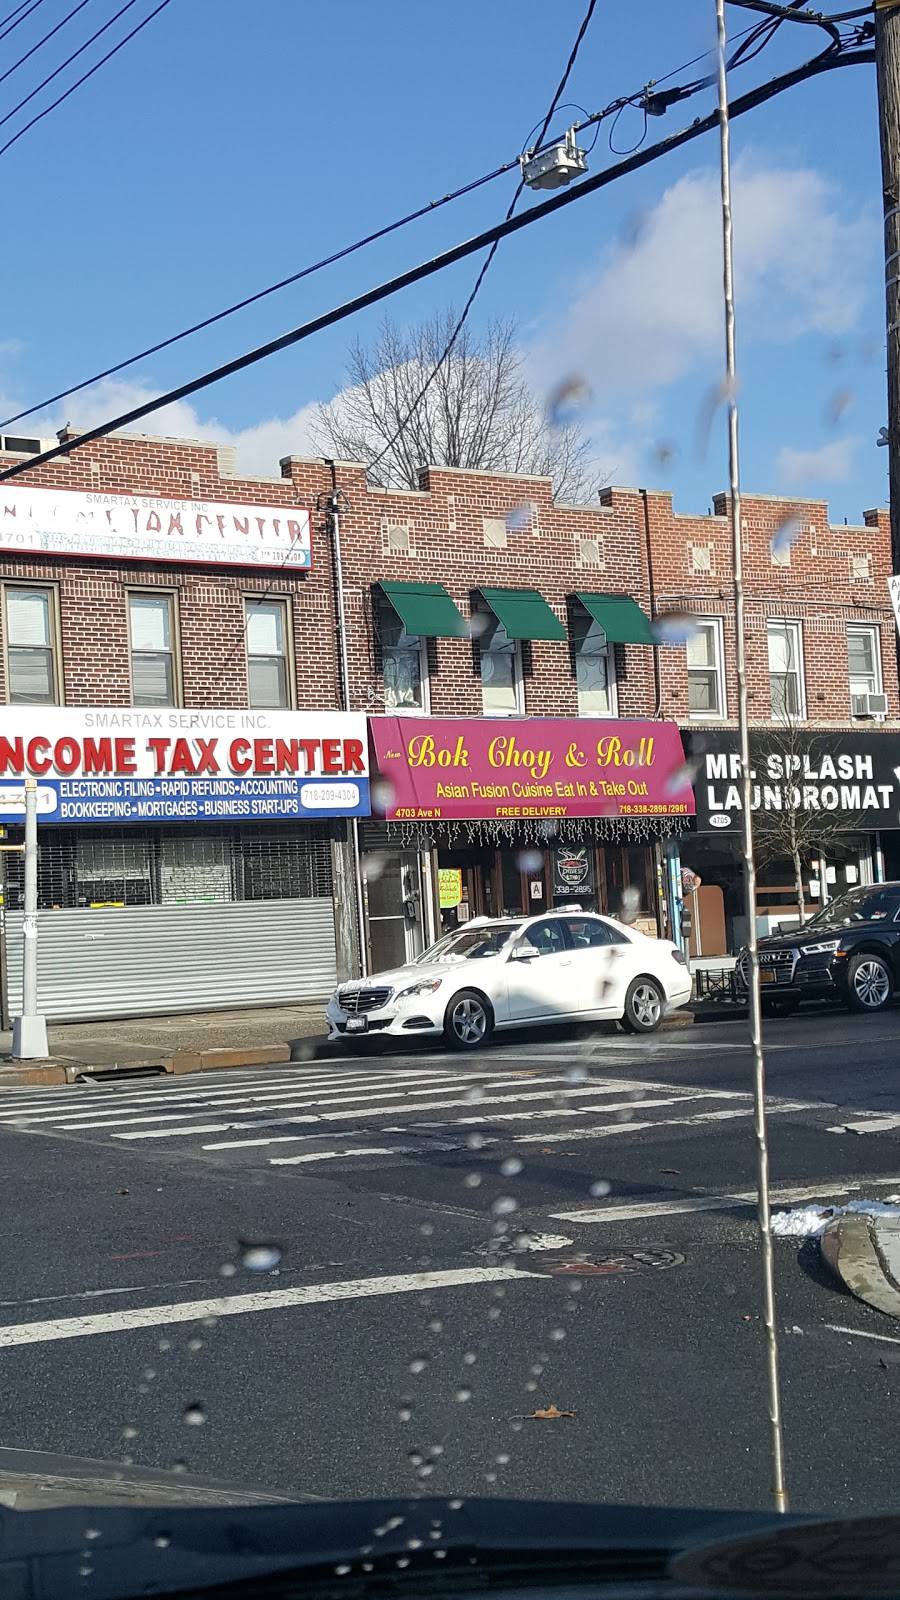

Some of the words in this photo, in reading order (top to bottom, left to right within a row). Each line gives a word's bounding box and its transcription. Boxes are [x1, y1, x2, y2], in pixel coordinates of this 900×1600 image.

[86, 493, 139, 507] SMARTAX
[142, 498, 187, 511] SERVICE
[84, 713, 163, 728] SMARTAX
[168, 715, 235, 729] SERVICE
[241, 715, 271, 729] INC.
[147, 738, 221, 774] TAX
[229, 737, 366, 774] CENTER
[407, 734, 470, 768] Bok
[488, 735, 554, 779] Choy
[565, 742, 588, 767] &
[597, 735, 656, 767] Roll
[705, 754, 757, 780] MR.
[767, 754, 873, 780] SPLASH
[60, 782, 123, 797] ELECTRONIC
[304, 789, 356, 801] 718-209-4304
[436, 782, 469, 798] Asian
[471, 781, 511, 798] Fusion
[512, 781, 553, 797] Cuisine
[555, 781, 575, 797] Eat
[578, 781, 587, 796] In
[589, 781, 599, 796] &
[599, 781, 625, 796] Take
[627, 780, 649, 795] Out
[707, 785, 894, 810] LAUNDROMAT
[251, 799, 298, 814] START-UPS
[395, 808, 416, 818] 4703
[417, 808, 433, 817] Ave
[433, 808, 441, 817] N
[496, 807, 520, 817] FREE
[522, 806, 567, 816] DELIVERY
[712, 817, 729, 825] 4705
[533, 884, 540, 894] A
